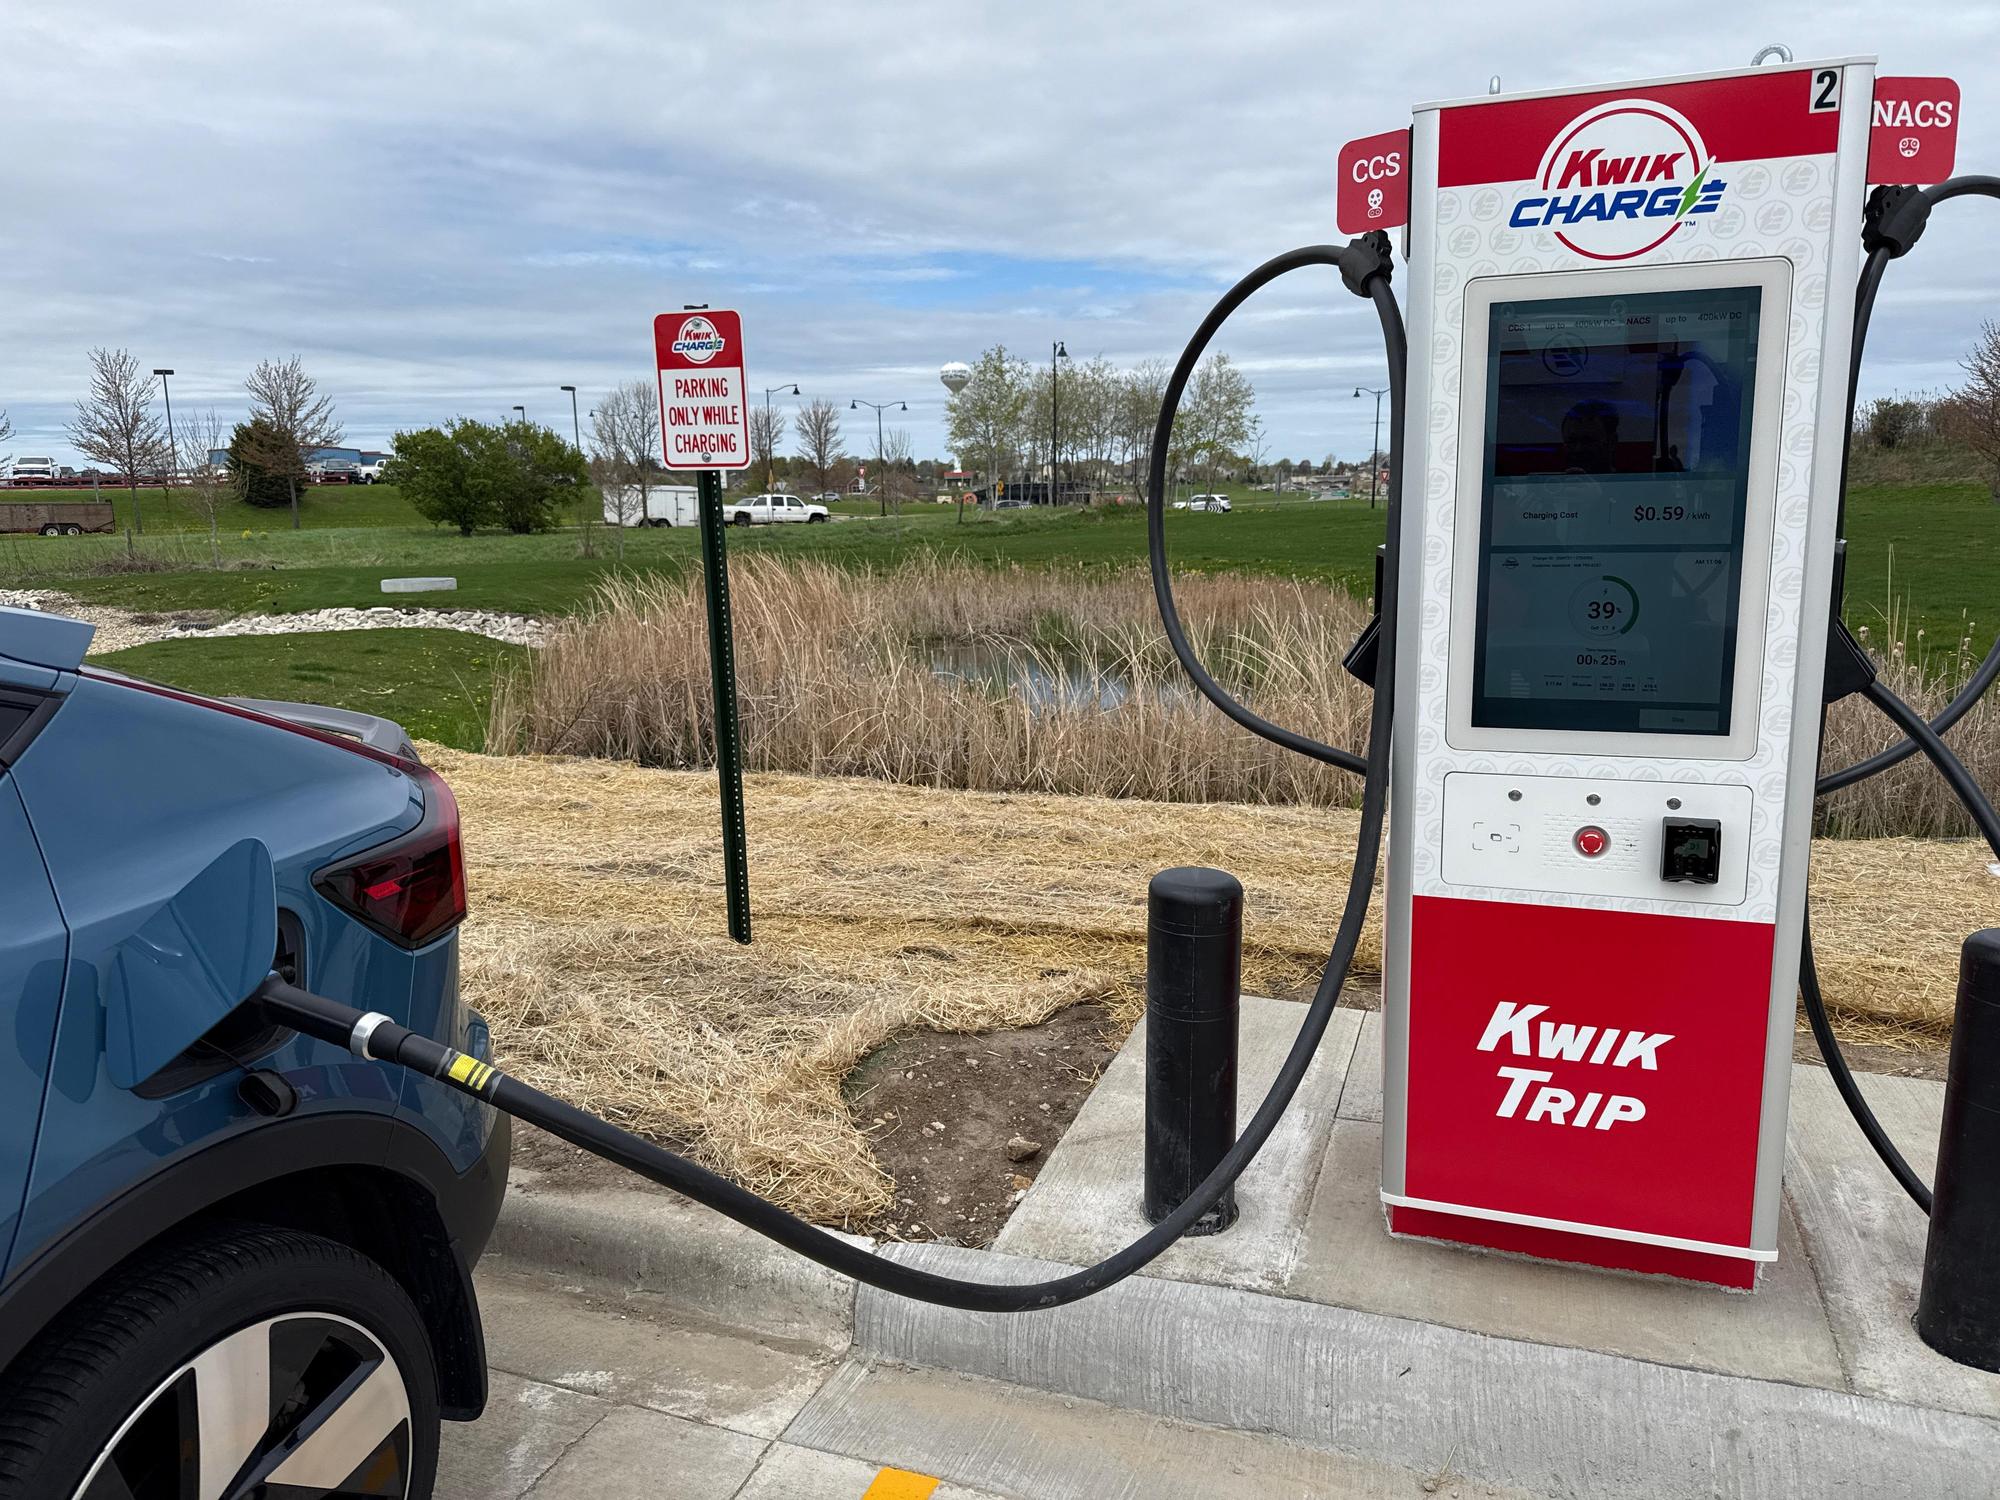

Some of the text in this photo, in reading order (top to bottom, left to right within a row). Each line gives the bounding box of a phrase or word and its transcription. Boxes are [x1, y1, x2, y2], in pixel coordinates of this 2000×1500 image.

[1815, 71, 1837, 109] 2
[1872, 100, 1953, 128] NACS
[1352, 152, 1401, 183] CCS
[1508, 178, 1727, 228] CHARGE
[1626, 316, 1651, 326] NACS
[1665, 317, 1677, 325] up
[1678, 314, 1687, 323] to
[675, 377, 729, 399] PARKING
[669, 405, 739, 426] ONLY WHILE
[675, 433, 737, 453] CHARGING
[1522, 511, 1558, 521] Charging
[1559, 510, 1578, 520] Cost
[1634, 505, 1684, 522] $0.59
